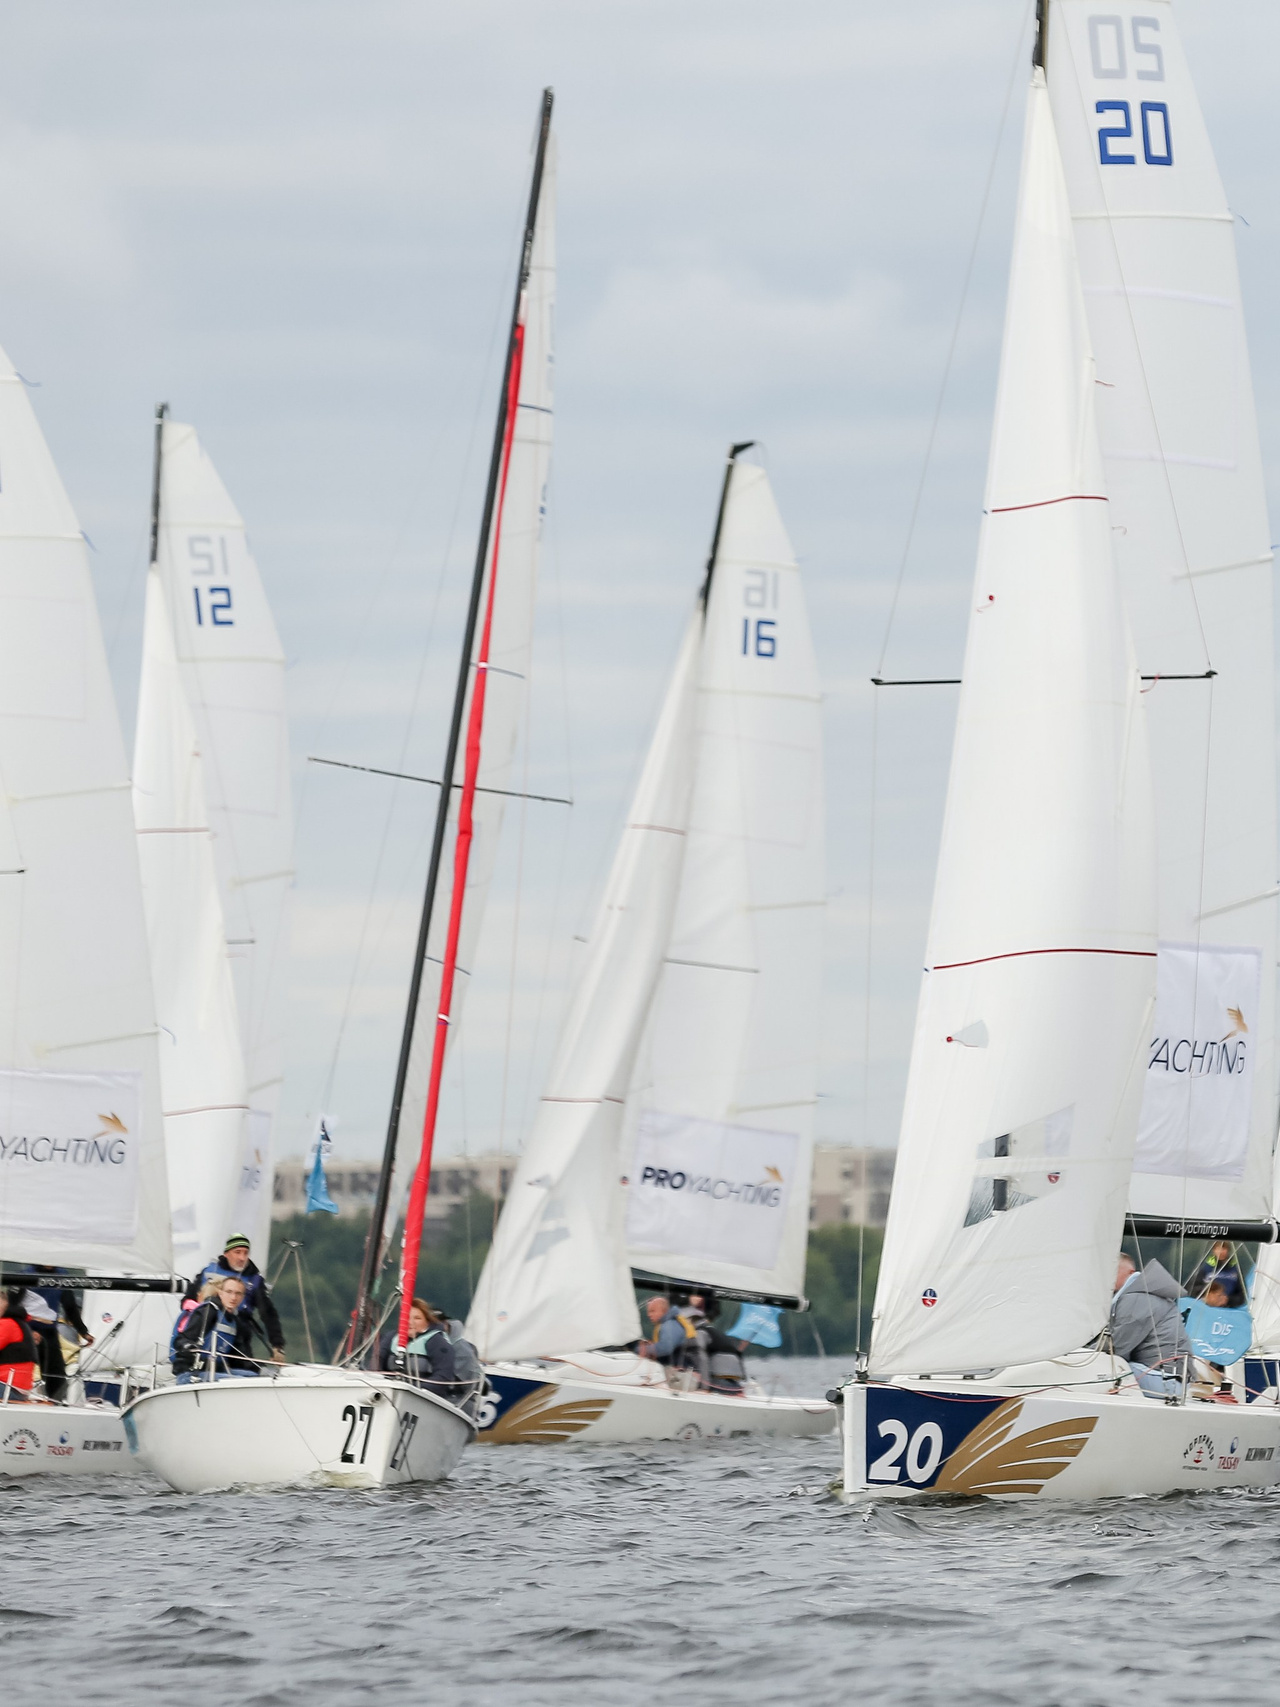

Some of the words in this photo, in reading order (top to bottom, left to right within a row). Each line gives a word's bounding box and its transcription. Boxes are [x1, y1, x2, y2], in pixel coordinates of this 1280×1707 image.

[1095, 99, 1174, 166] 20
[193, 587, 235, 627] 12
[742, 618, 778, 659] 16
[641, 1165, 782, 1208] PROYACHTING
[1164, 1221, 1229, 1238] pro-yachting.ru
[340, 1404, 375, 1464] 27
[389, 1411, 420, 1471] 27
[868, 1419, 944, 1484] 20
